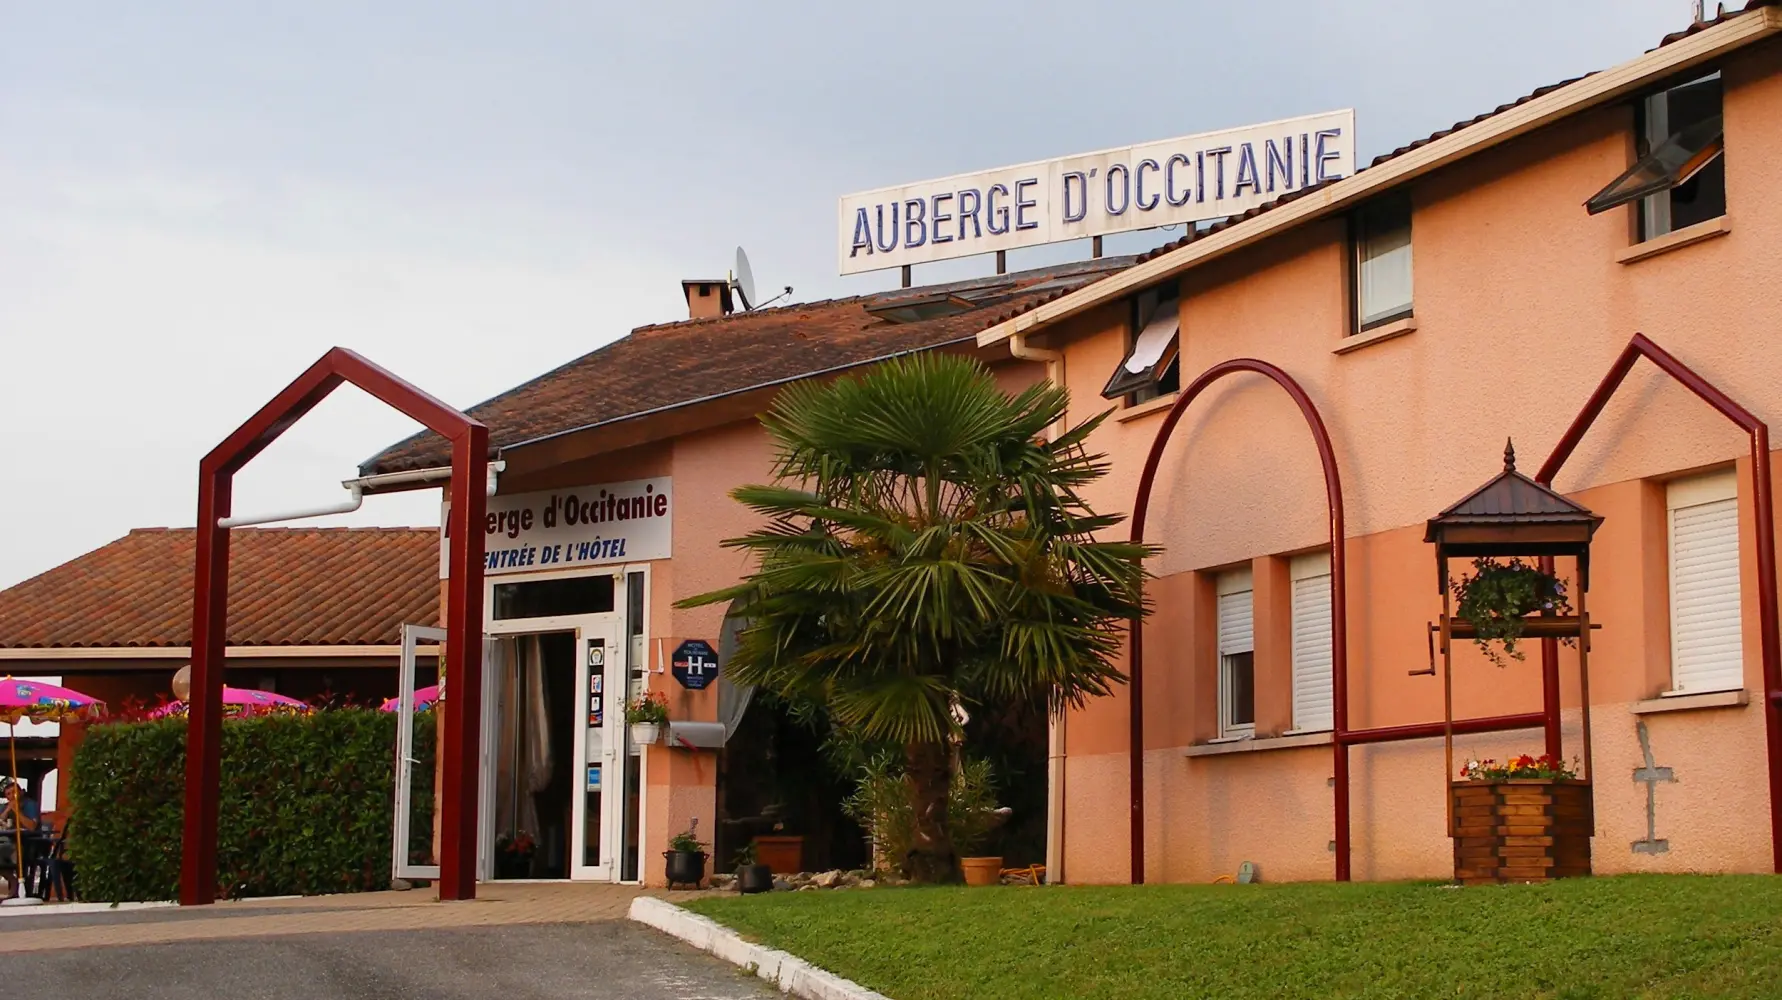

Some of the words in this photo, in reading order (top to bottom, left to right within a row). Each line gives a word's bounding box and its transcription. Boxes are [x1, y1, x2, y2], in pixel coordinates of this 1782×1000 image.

[849, 177, 1038, 258] AUBERGE
[1062, 127, 1341, 223] D'OCCITANIE
[444, 507, 533, 539] erge
[543, 483, 668, 529] d'Occitanie
[541, 546, 561, 564] DE
[566, 536, 626, 561] L'HÔTEL
[687, 656, 703, 675] H
